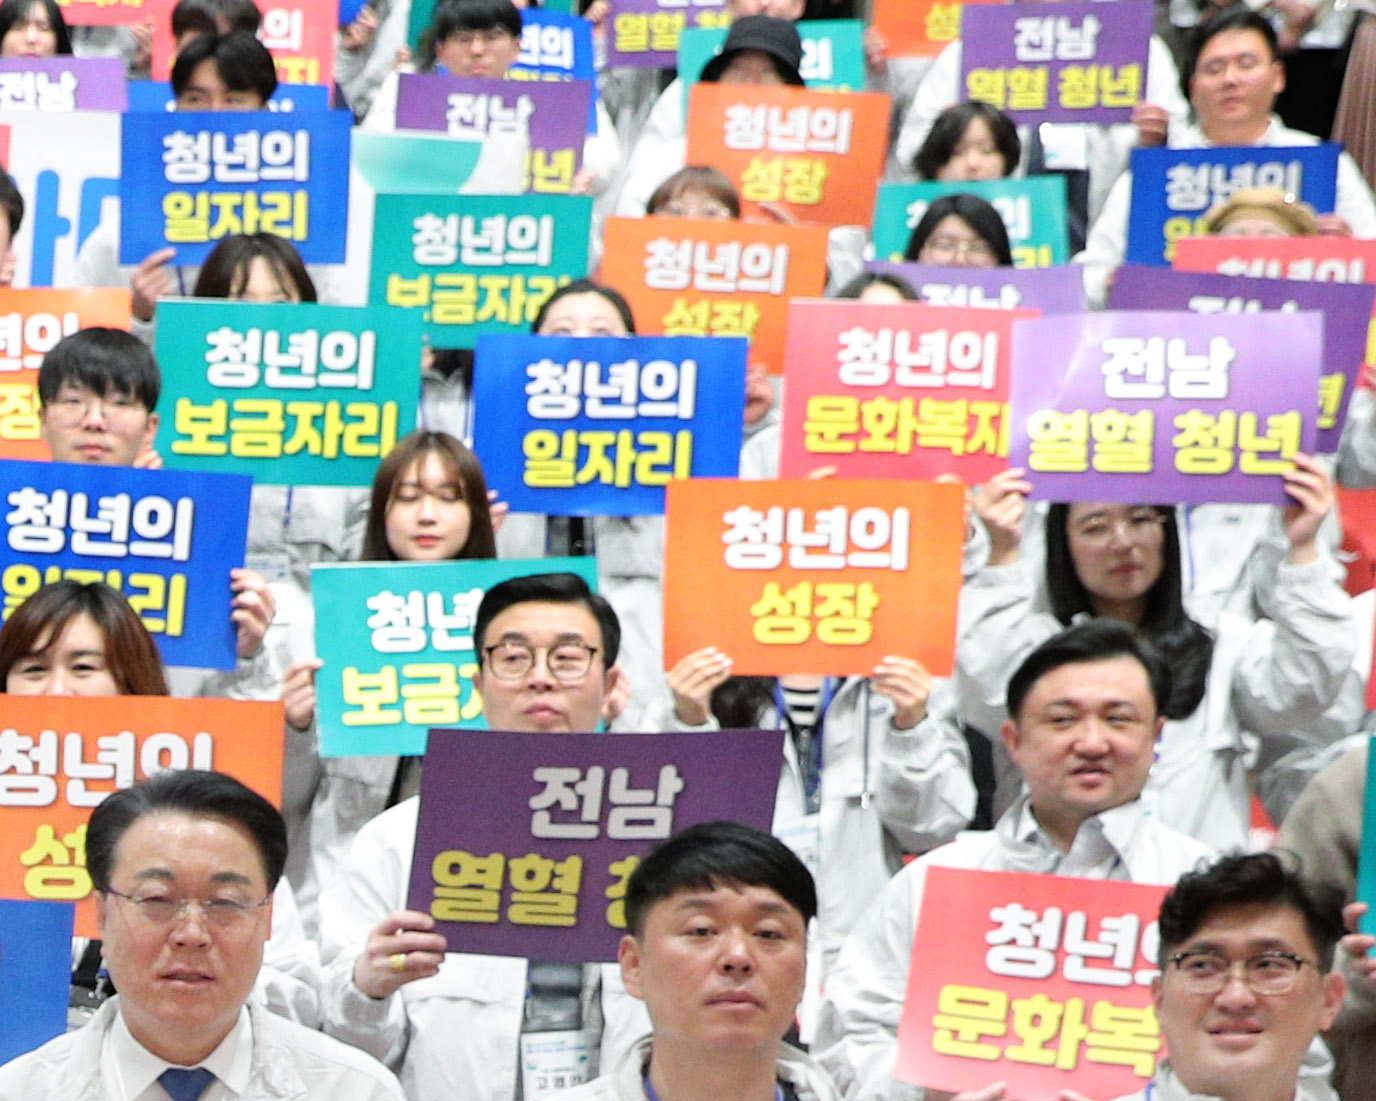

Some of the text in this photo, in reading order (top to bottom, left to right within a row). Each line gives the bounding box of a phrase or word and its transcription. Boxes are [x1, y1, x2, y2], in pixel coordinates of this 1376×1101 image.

[1015, 15, 1101, 62] 전남
[1058, 66, 1141, 108] 청년
[162, 130, 310, 183] 청년의
[724, 104, 852, 153] 청년의
[524, 150, 575, 192] 년
[742, 156, 828, 205] 성장
[162, 190, 308, 243] 일자리
[413, 214, 554, 265] 청년의
[645, 239, 789, 294] 청년의
[205, 327, 377, 390] 청년의
[837, 328, 998, 389] 청년의
[1101, 336, 1235, 400] 전남
[524, 359, 698, 420] 청년의
[170, 398, 399, 458] 보금자리
[803, 396, 1010, 456] 문화복지
[1027, 410, 1301, 475] 열혈 청년
[522, 429, 693, 488] 일자리
[5, 487, 195, 562] 청년의
[722, 506, 911, 570] 청년의
[366, 590, 485, 653] 청년
[750, 582, 880, 645] 성장
[342, 664, 482, 726] 보금
[529, 764, 684, 840] 전남
[20, 824, 93, 900] 성
[430, 850, 583, 928] 열혈
[985, 902, 1162, 987] 청년
[932, 984, 1162, 1077] 문화복
